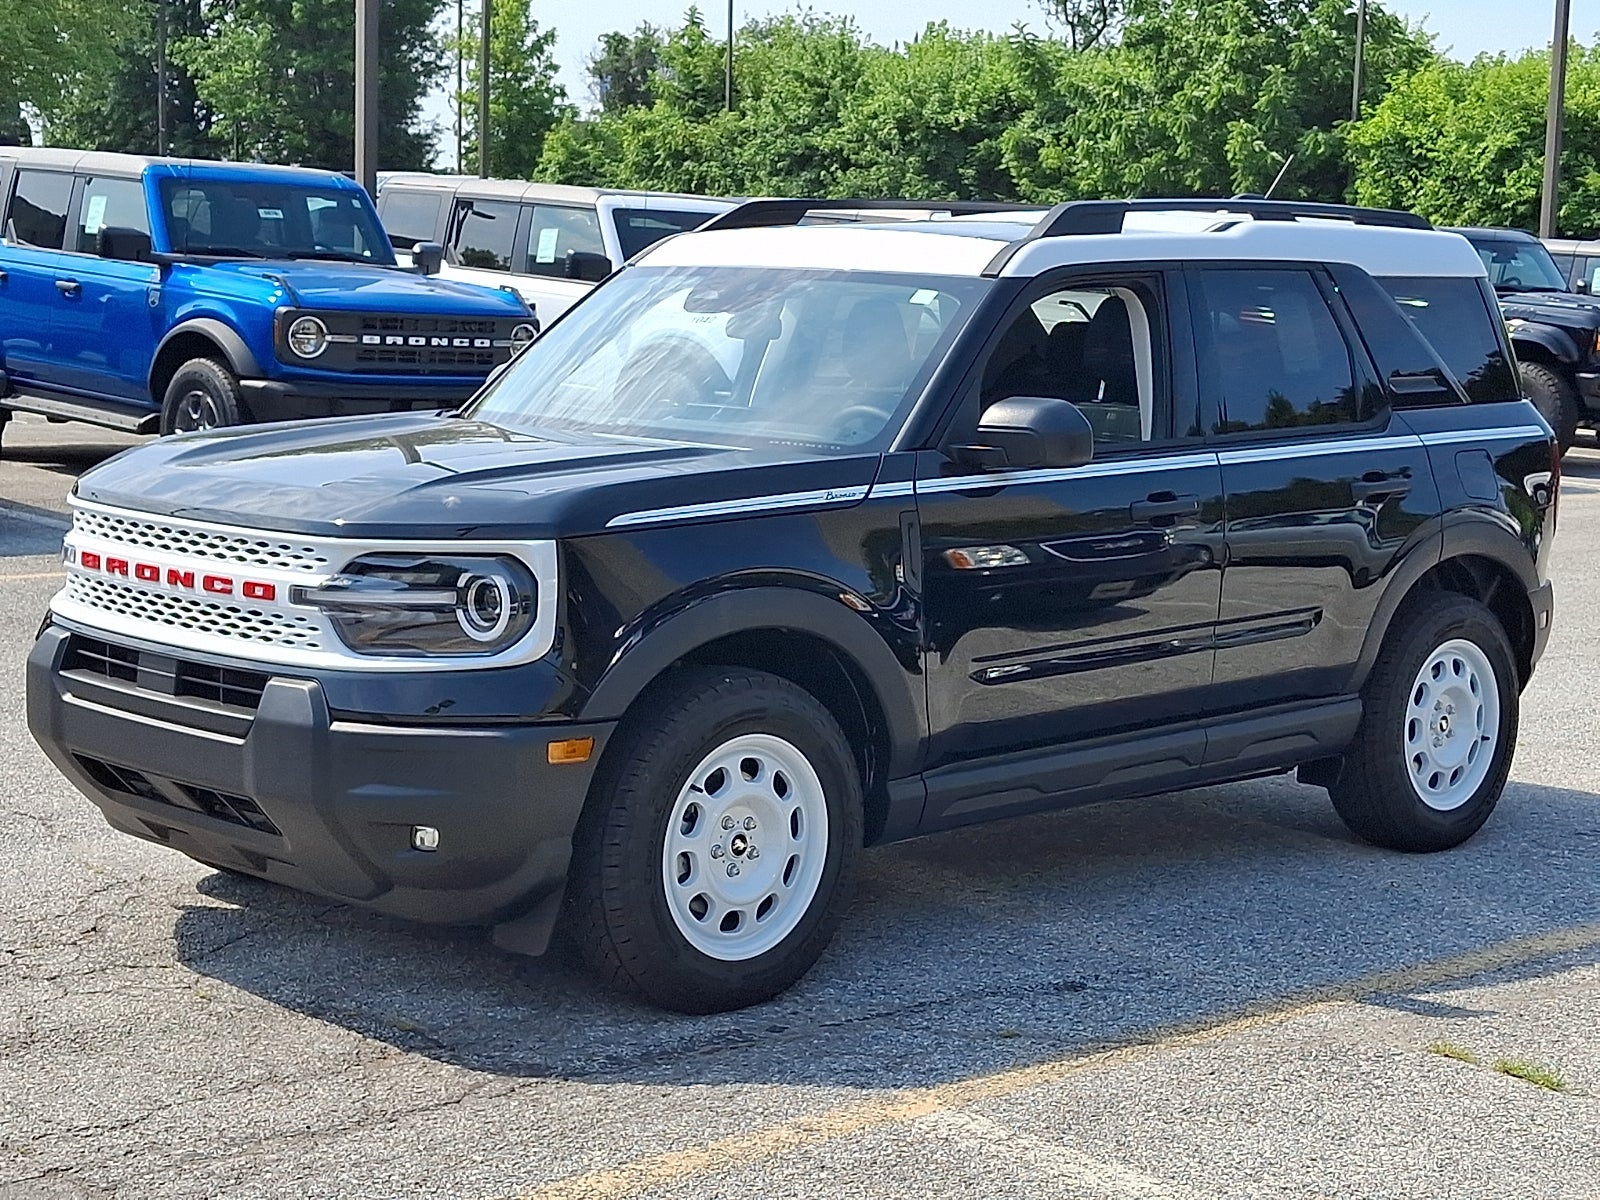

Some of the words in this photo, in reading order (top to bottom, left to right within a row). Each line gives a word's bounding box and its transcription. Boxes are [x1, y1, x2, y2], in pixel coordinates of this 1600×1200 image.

[362, 334, 491, 348] BRONCO
[824, 490, 857, 501] Bronco
[80, 550, 276, 601] BRONCO
